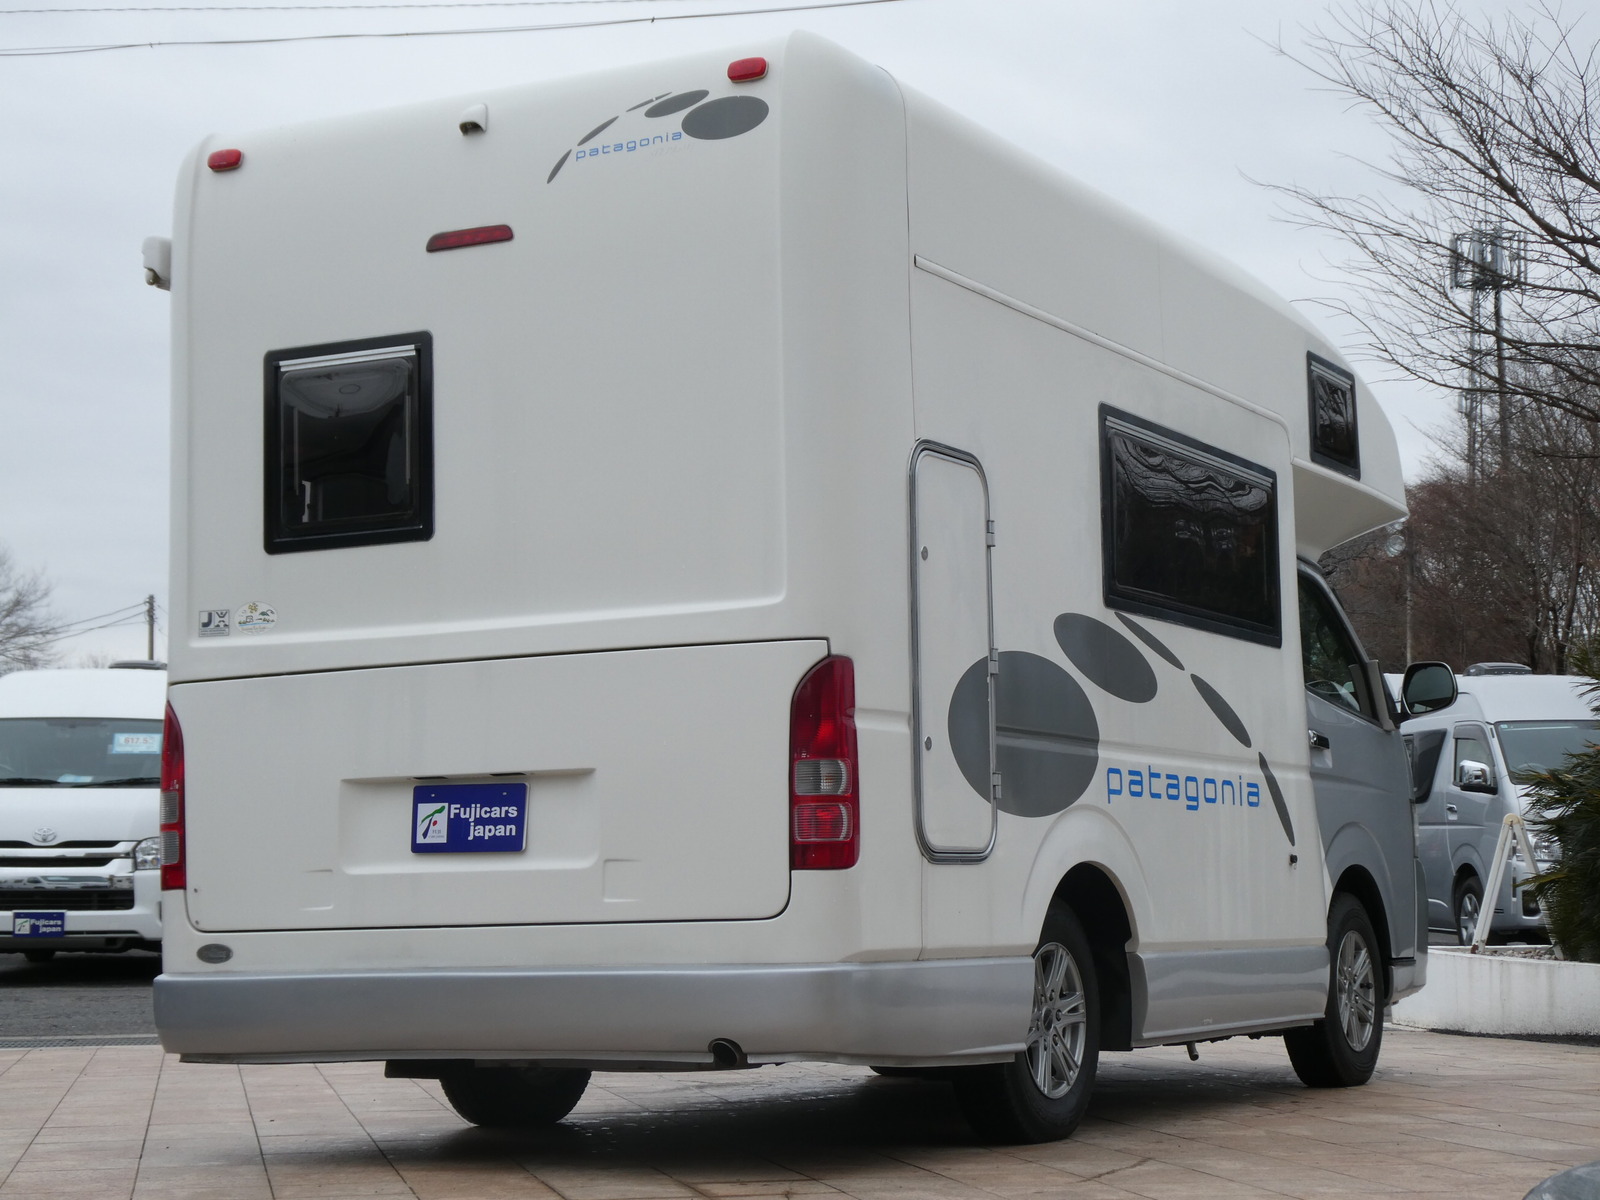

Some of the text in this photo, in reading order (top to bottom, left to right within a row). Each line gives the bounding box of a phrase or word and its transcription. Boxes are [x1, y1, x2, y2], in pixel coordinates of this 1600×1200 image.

[575, 131, 682, 162] patagonia
[1107, 765, 1260, 811] patagonia
[450, 804, 518, 822] Fujicars
[468, 822, 516, 841] japan
